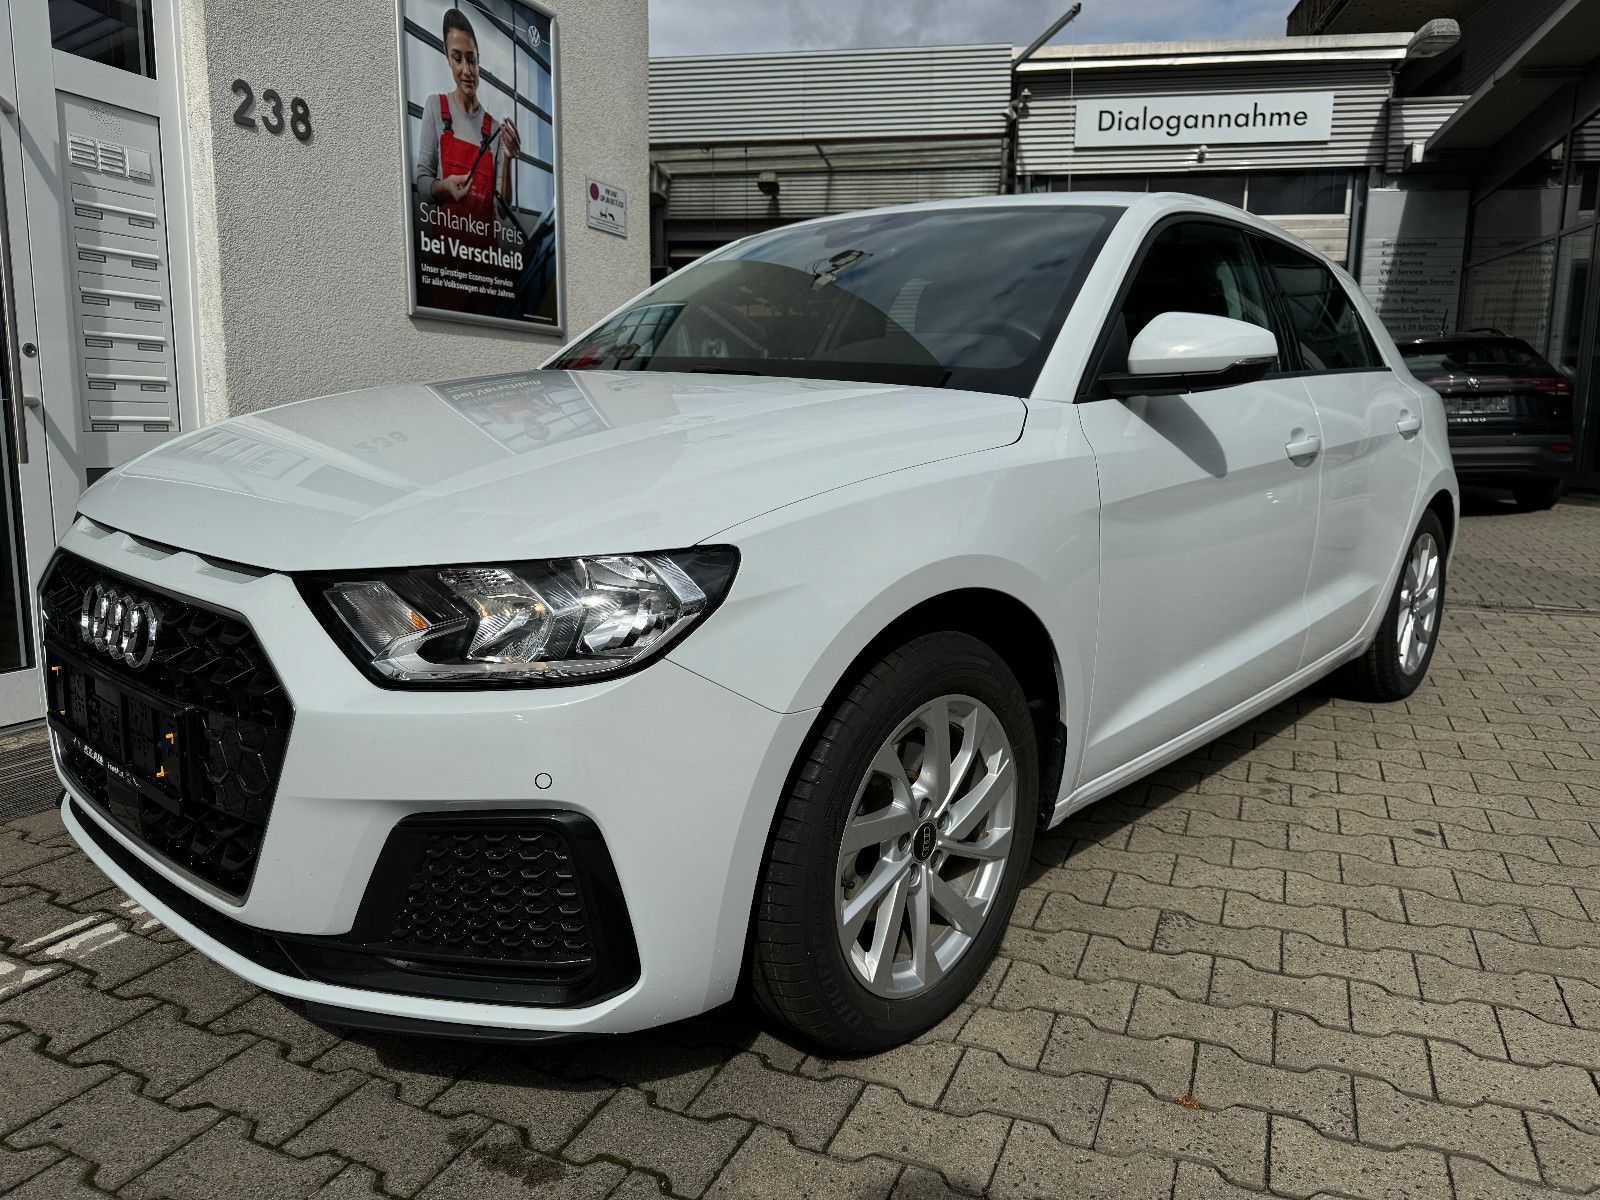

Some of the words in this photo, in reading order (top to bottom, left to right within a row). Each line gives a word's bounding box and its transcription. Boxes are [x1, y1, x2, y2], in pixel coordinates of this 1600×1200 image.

[231, 79, 312, 142] 238
[1098, 102, 1308, 137] Dialogannahme
[420, 202, 490, 236] Schlanker
[493, 220, 524, 245] Preis
[420, 230, 445, 255] bei
[447, 237, 523, 271] Verschleiß
[421, 263, 439, 274] Unser
[440, 267, 468, 280] günstiger
[468, 272, 493, 285] Economy
[494, 277, 514, 288] Service
[422, 275, 431, 285] für
[432, 276, 443, 286] alle
[444, 279, 478, 293] Volkswagen
[479, 285, 487, 294] ab
[487, 287, 497, 296] vier
[497, 288, 516, 299] Jahren
